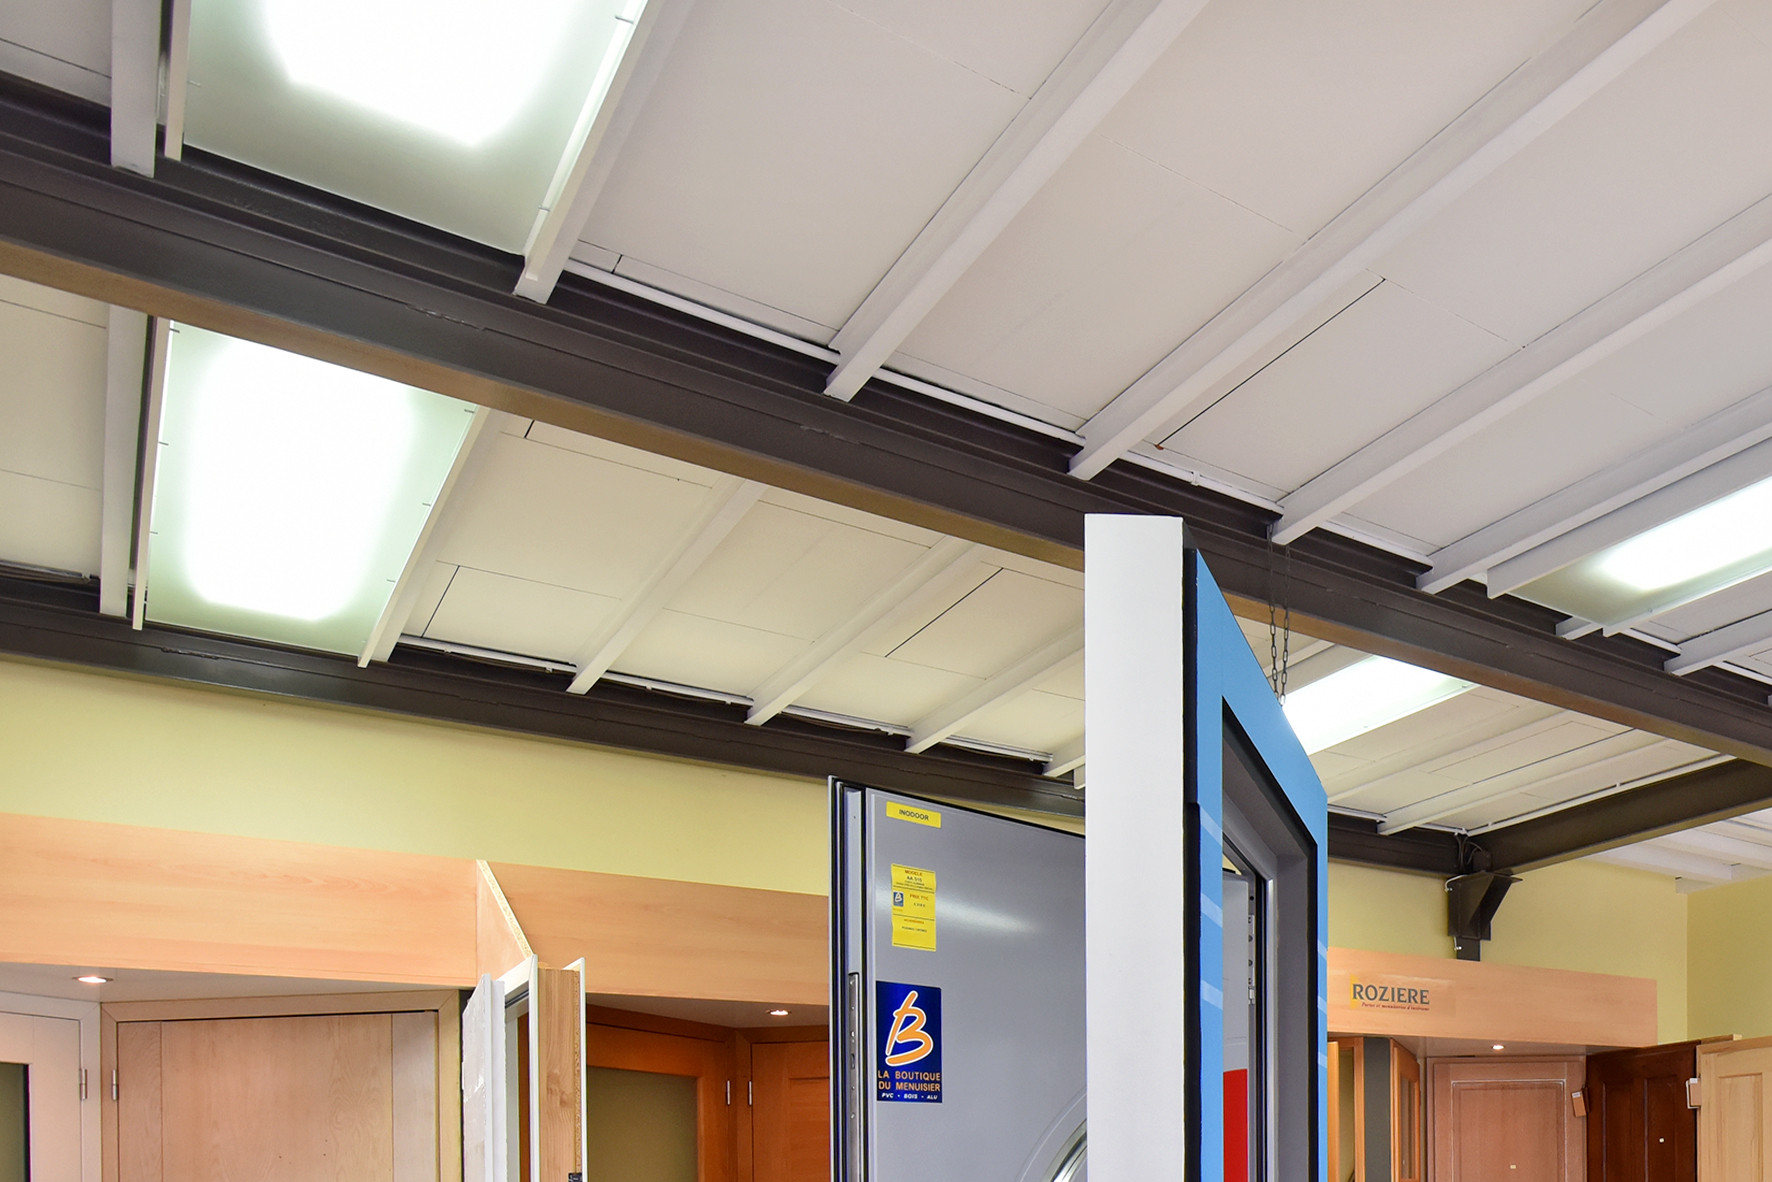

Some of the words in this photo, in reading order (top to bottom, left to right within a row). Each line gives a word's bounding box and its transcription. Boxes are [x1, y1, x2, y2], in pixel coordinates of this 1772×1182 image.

[899, 809, 929, 821] INODOOR
[1352, 984, 1430, 1005] ROZIERE
[878, 1070, 890, 1079] LA
[895, 1070, 941, 1081] BOUTIQUE
[878, 1081, 891, 1090] DU
[895, 1081, 941, 1092] MENUISIER
